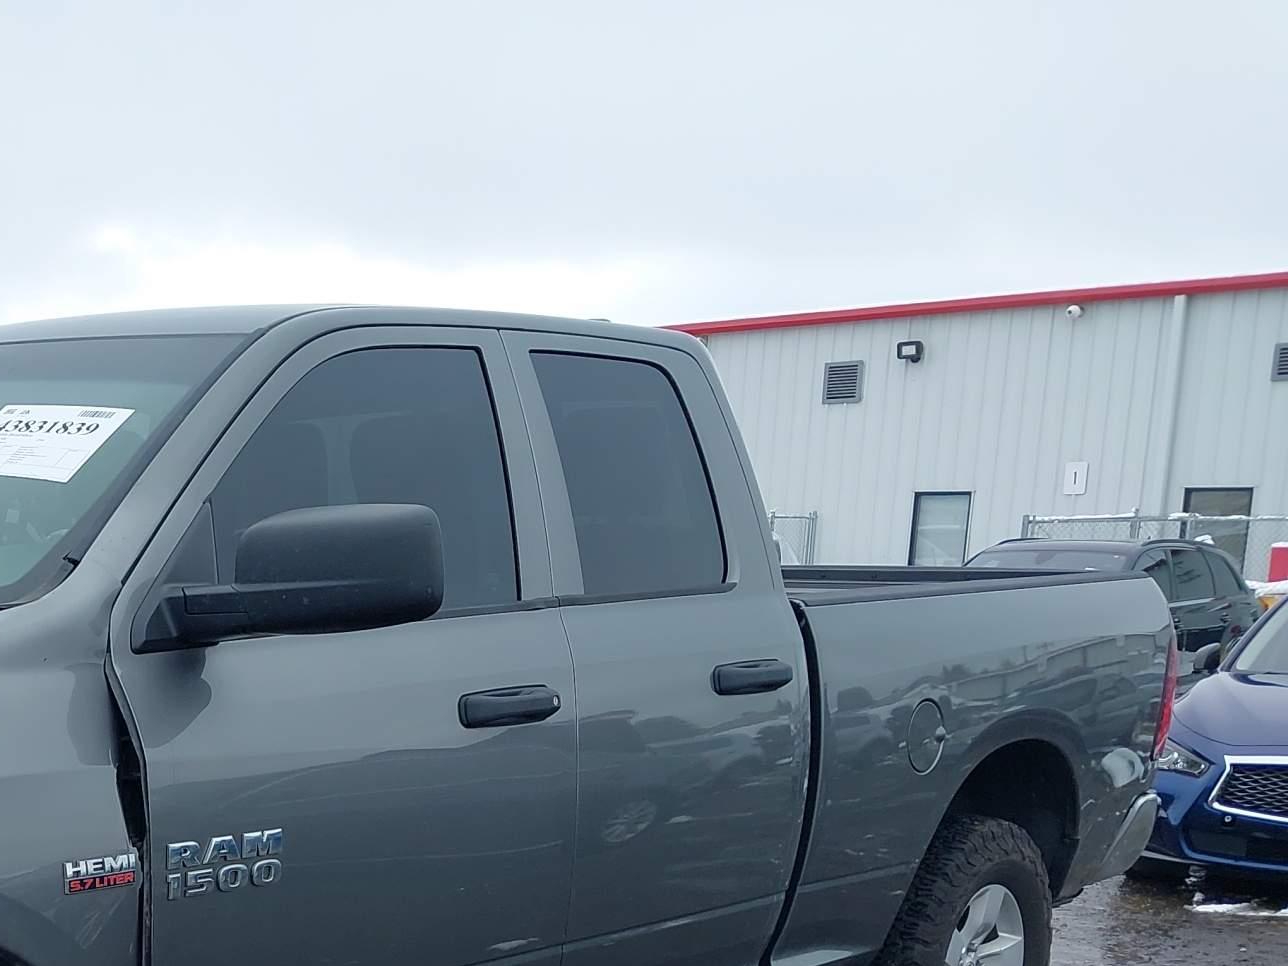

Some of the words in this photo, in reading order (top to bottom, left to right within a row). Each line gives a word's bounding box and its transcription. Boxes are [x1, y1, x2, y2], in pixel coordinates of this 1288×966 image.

[65, 853, 136, 878] HEMI
[166, 828, 283, 870] RAM
[69, 880, 94, 892] 5.7
[96, 871, 135, 888] LITER
[167, 858, 283, 901] 1500
